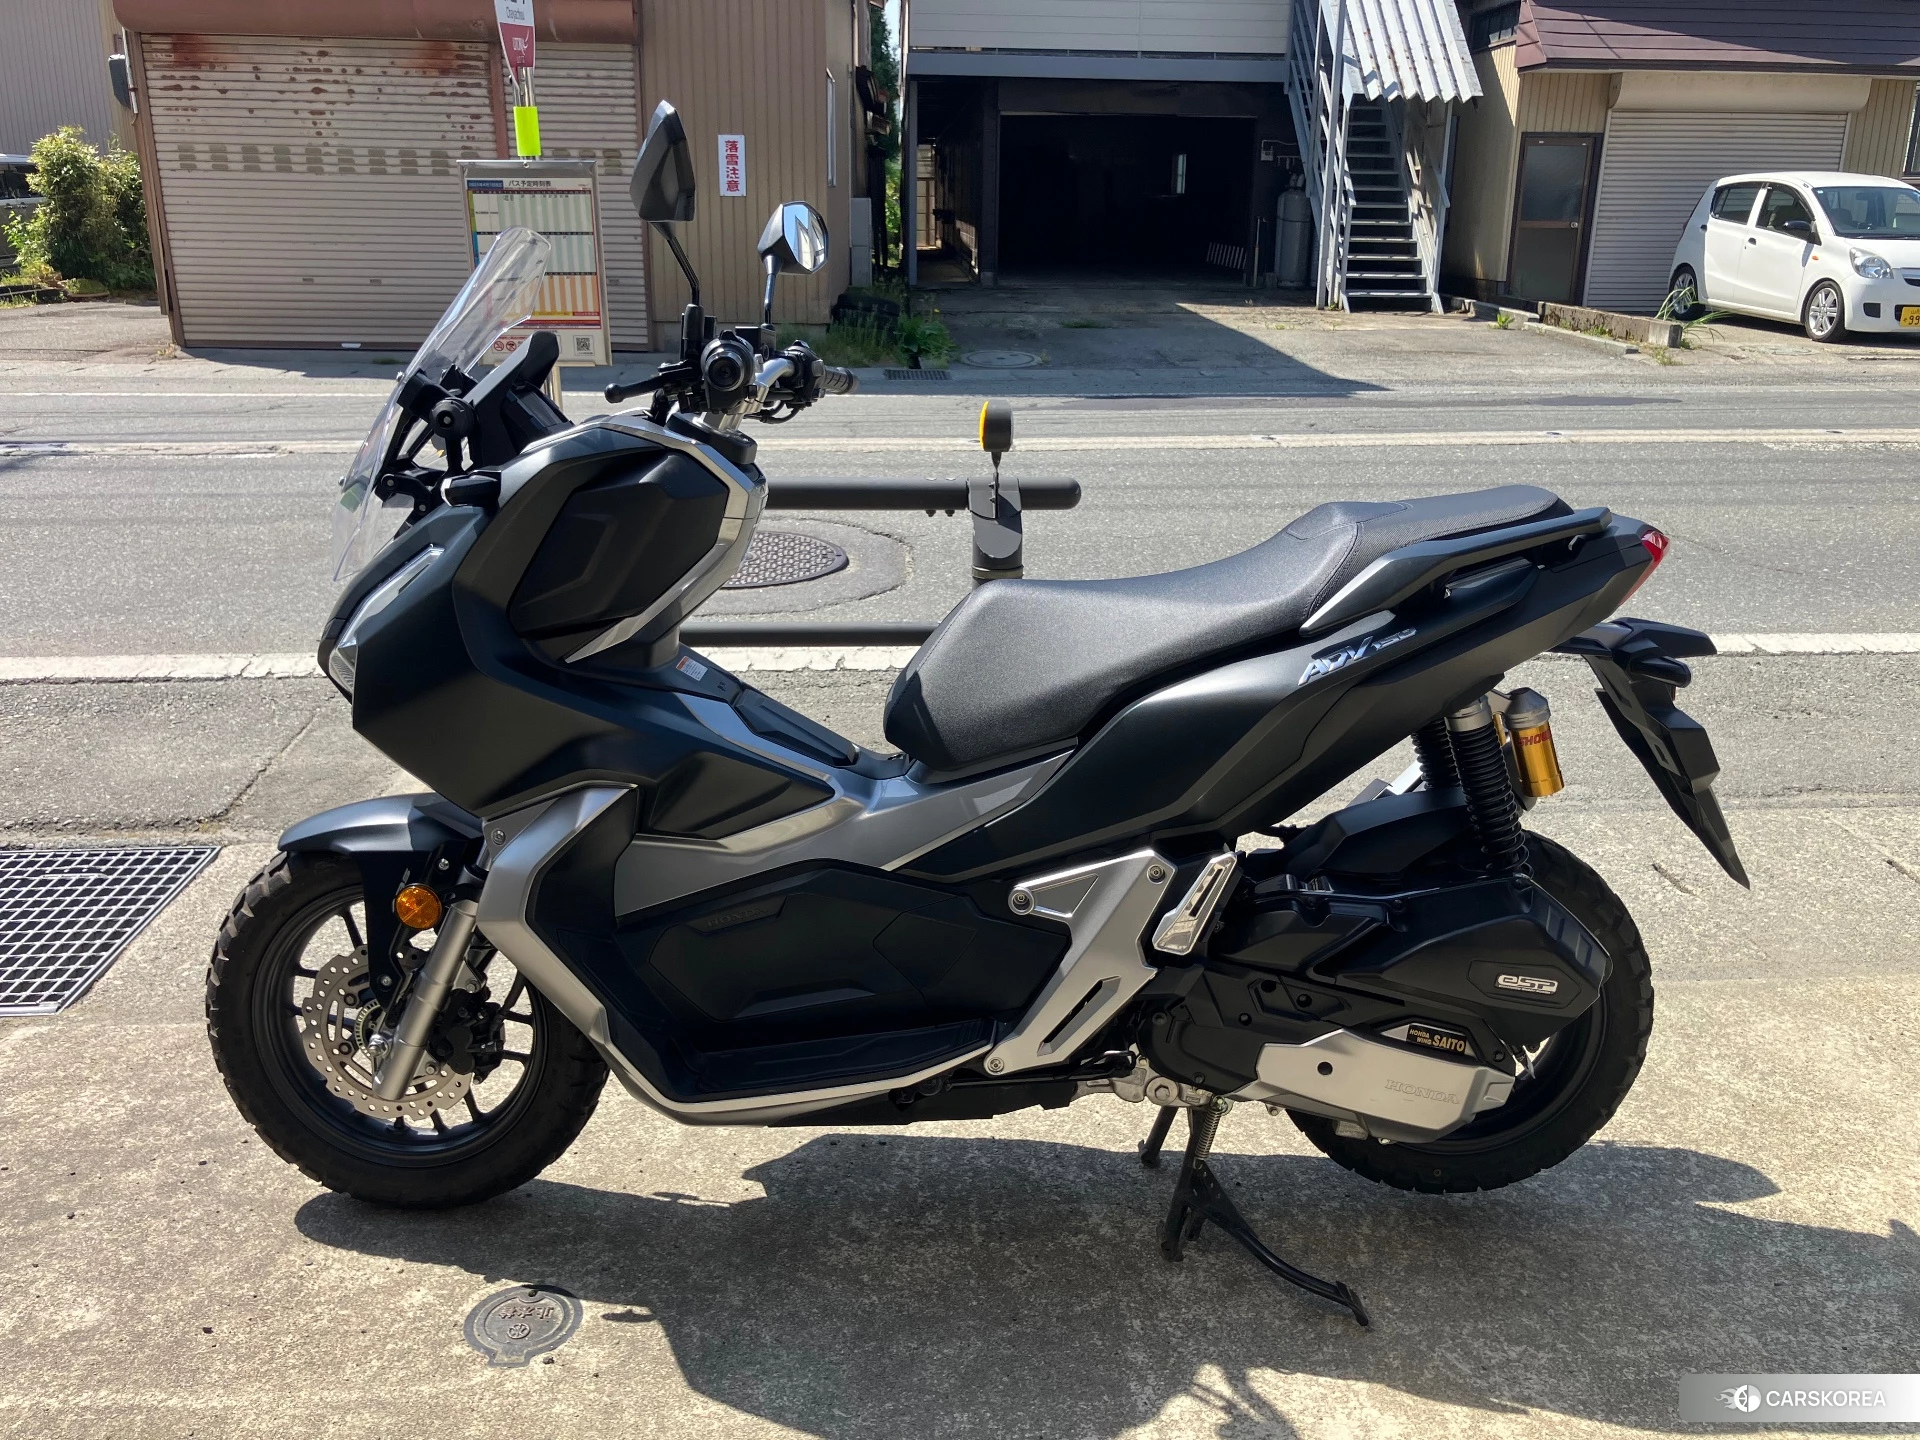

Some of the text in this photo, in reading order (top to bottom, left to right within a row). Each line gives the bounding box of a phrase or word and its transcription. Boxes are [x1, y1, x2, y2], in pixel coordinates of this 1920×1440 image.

[724, 139, 740, 192] 落雪注意
[1298, 635, 1374, 686] ADV
[706, 905, 768, 927] HONDA
[1409, 1028, 1430, 1039] HONDA
[1416, 1037, 1432, 1045] WING
[1432, 1034, 1465, 1052] SAITO
[1384, 1079, 1460, 1105] HONDA
